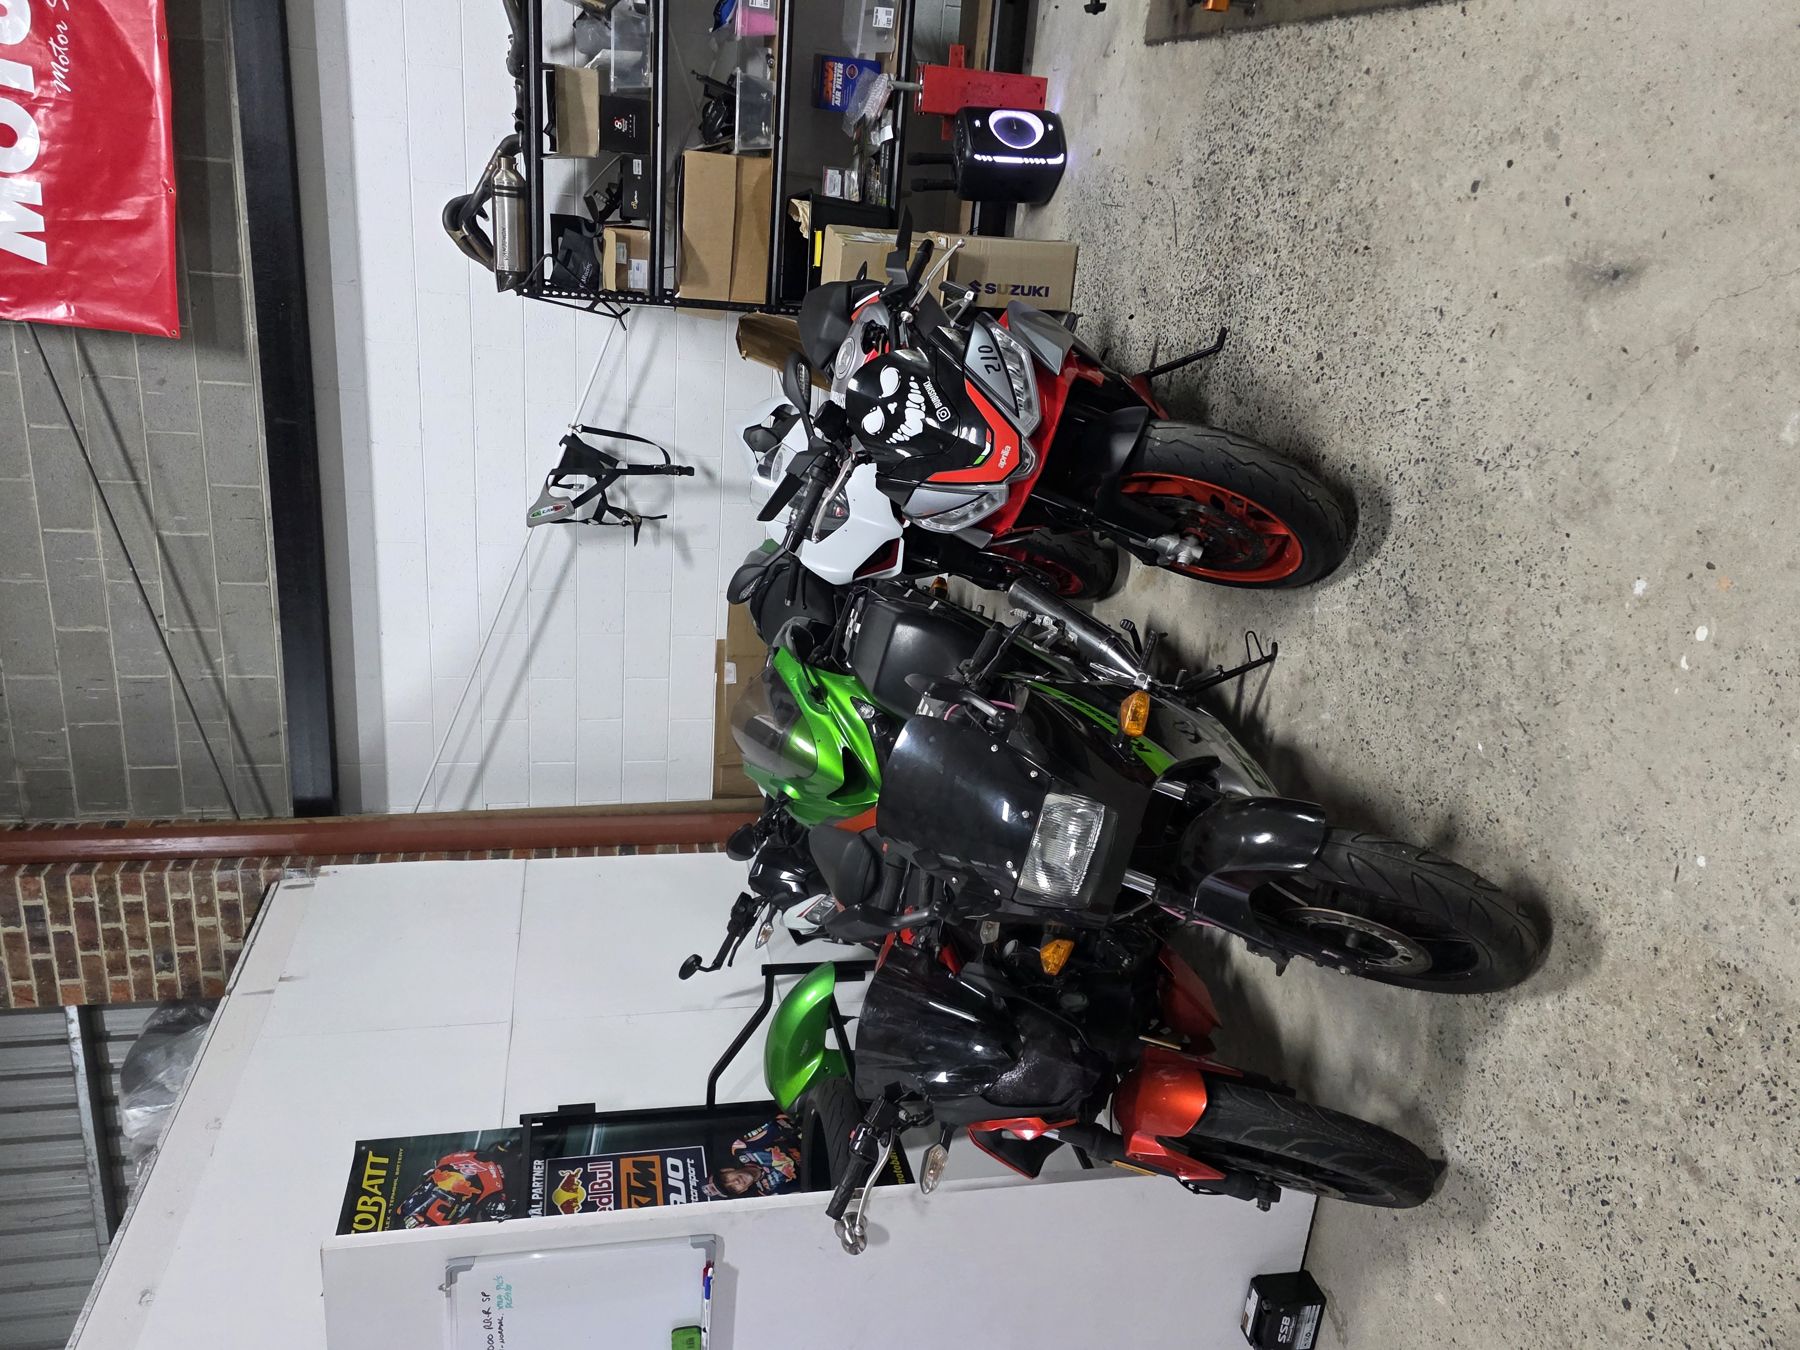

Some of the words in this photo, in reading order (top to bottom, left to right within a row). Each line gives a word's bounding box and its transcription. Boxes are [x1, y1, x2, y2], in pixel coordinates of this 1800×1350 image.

[48, 19, 71, 93] Motor
[836, 61, 844, 89] FILTER
[834, 90, 842, 107] AIR
[984, 282, 1050, 297] SUZUKI
[978, 344, 1001, 374] 210
[997, 444, 1011, 468] aprilia
[531, 1159, 545, 1199] PARTNER
[587, 1160, 613, 1193] Bull
[351, 1150, 389, 1234] OBATT
[480, 1290, 491, 1302] SP
[1277, 1315, 1291, 1343] SSB
